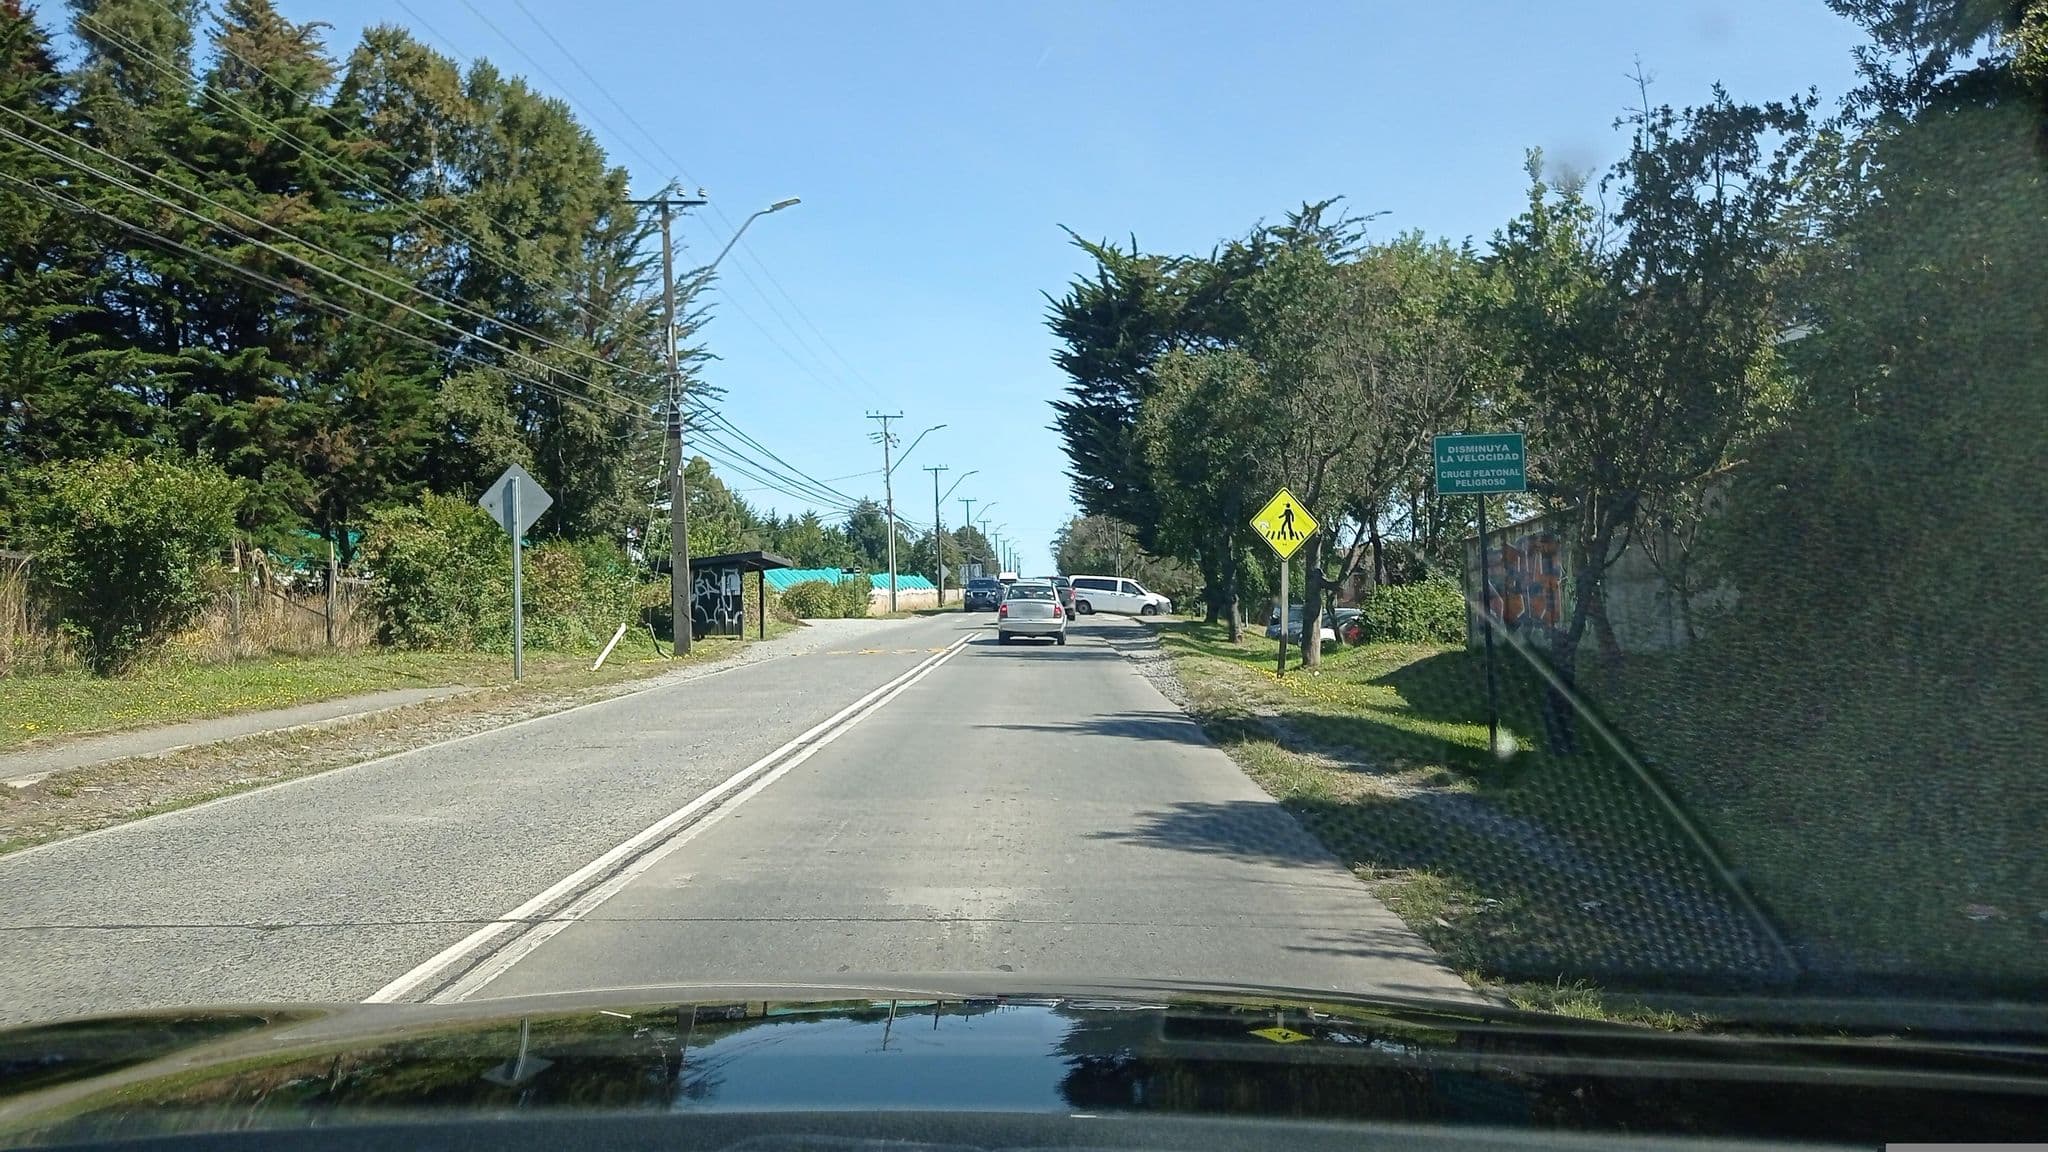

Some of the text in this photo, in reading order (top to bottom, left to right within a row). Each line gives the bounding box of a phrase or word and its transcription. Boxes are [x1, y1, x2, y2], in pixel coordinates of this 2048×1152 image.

[1448, 444, 1509, 453] DISMINUYA
[1440, 453, 1519, 463] LA VELOCIDAD
[1441, 468, 1520, 478] CRUCE PEATONAL
[1455, 478, 1506, 487] PELIGROSO
